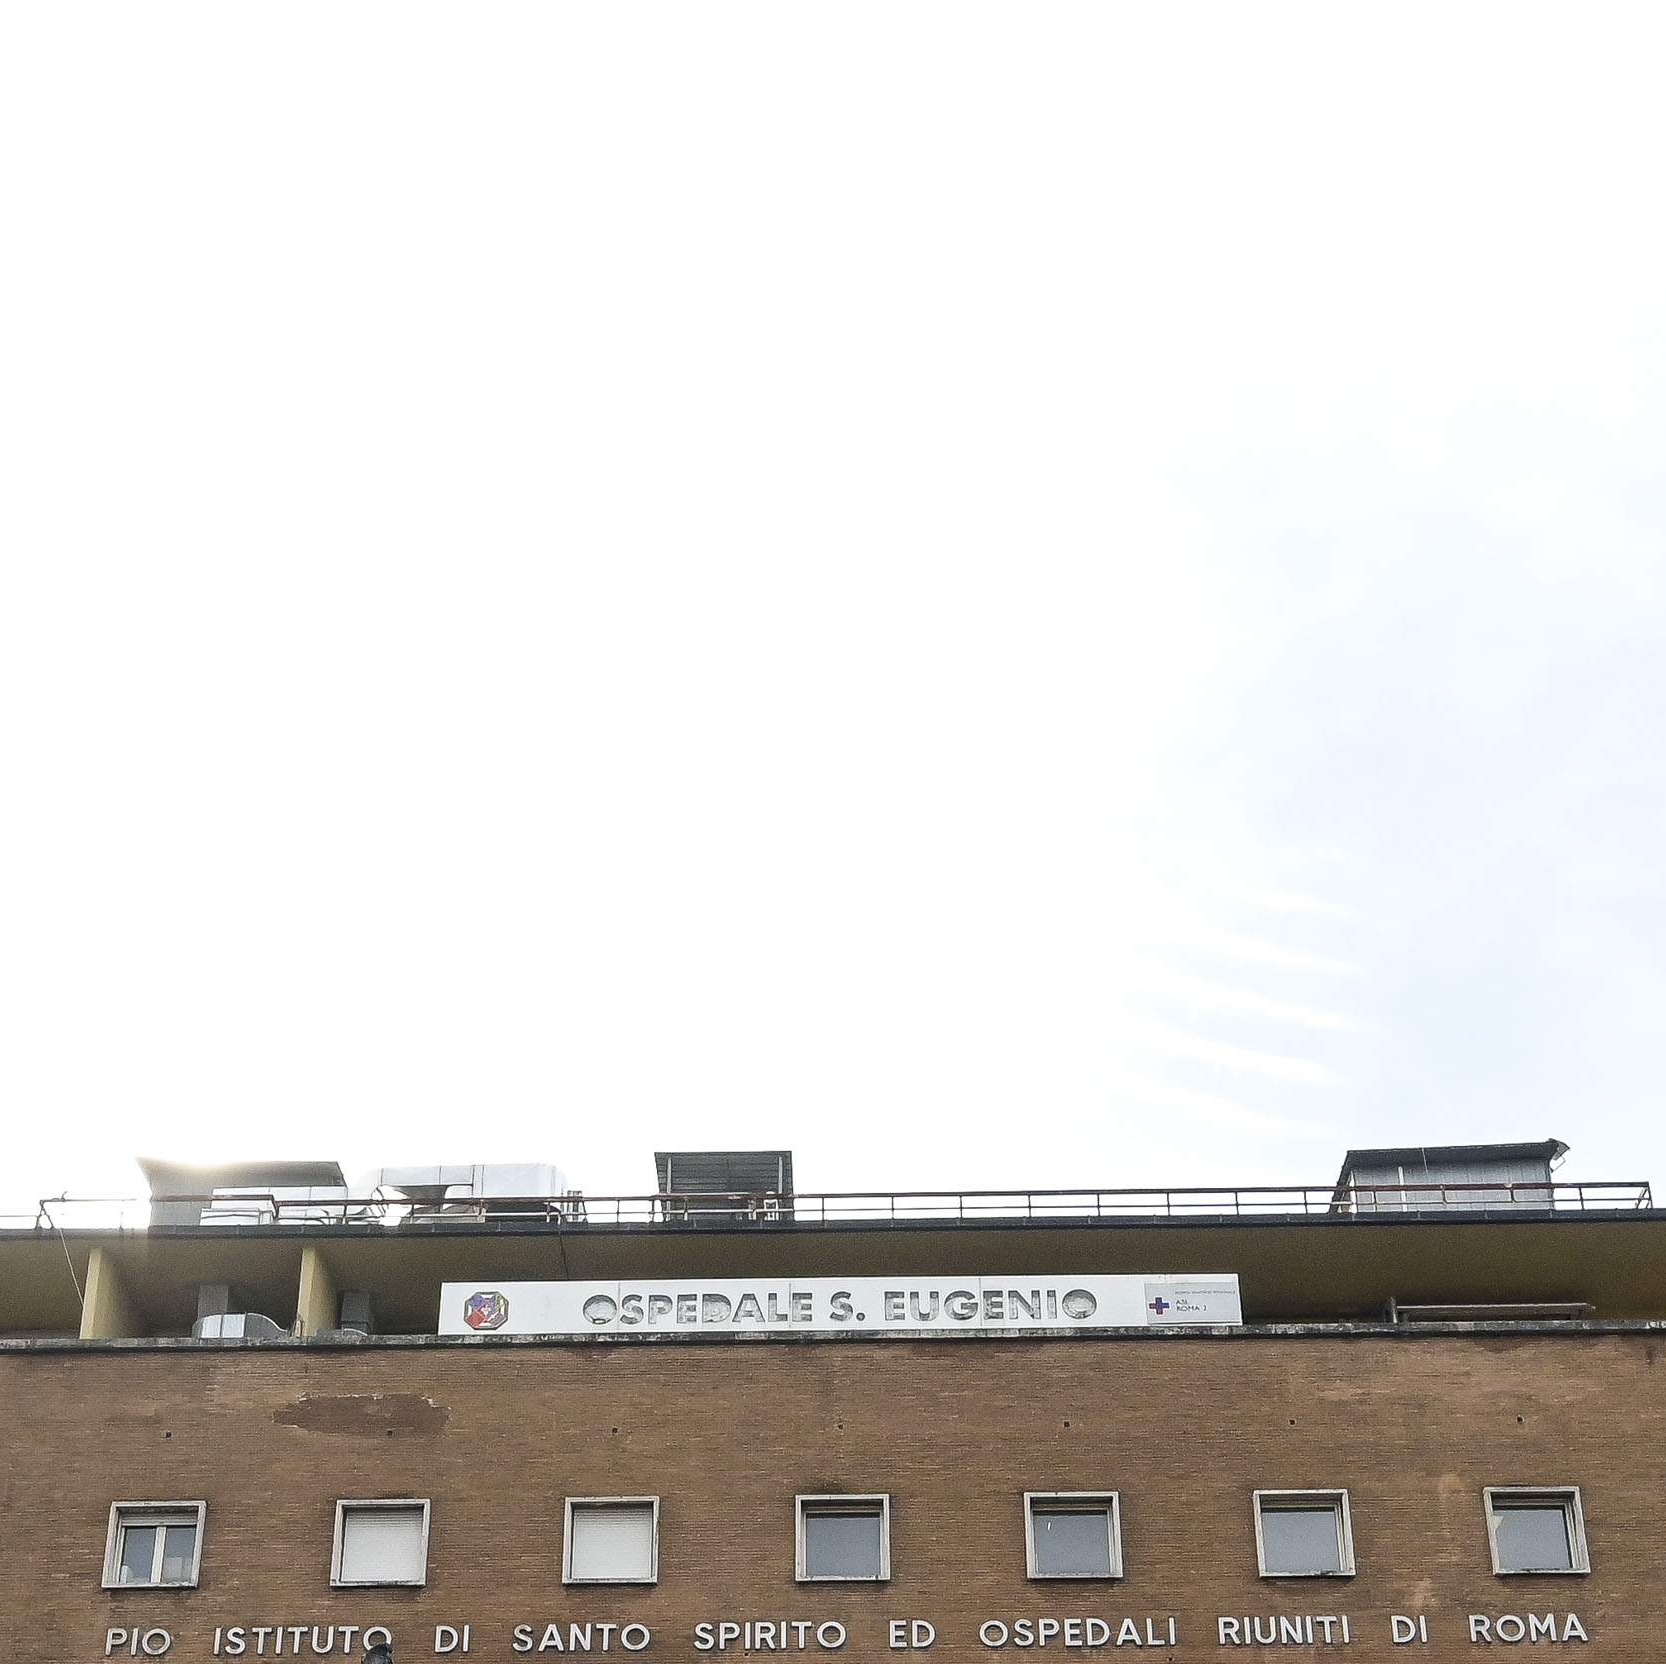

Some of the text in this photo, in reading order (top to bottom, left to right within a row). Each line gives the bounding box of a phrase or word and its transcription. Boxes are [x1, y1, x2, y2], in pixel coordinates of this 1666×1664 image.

[583, 1286, 1097, 1325] OSPEDALE S. EUGENIO
[104, 1614, 1590, 1656] PIO ISTITUTO DI SANTO SPIRITO ED OSPEDALI RIUNITI DI ROMA
